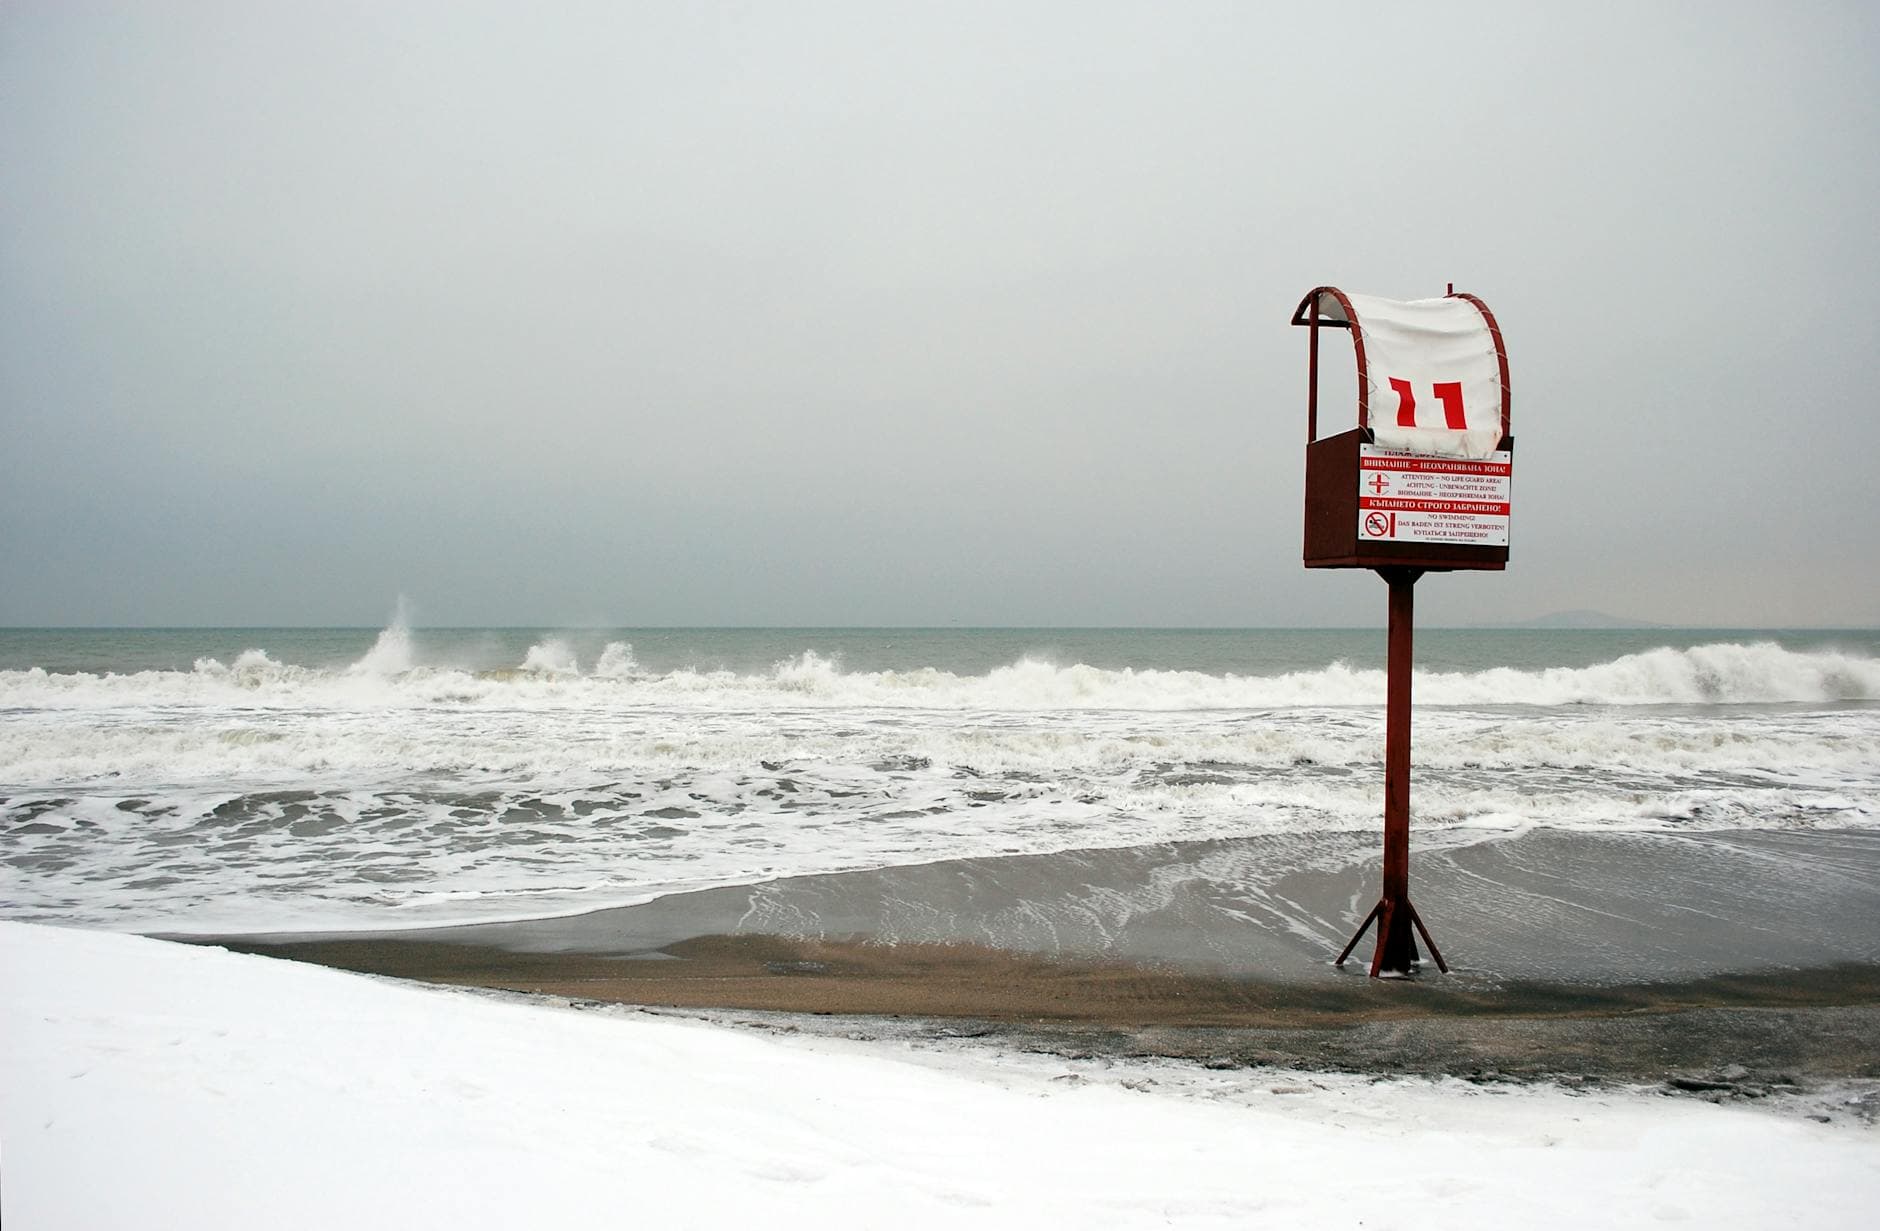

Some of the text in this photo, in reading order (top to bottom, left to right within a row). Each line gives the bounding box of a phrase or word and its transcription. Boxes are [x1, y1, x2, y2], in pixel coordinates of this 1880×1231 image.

[1388, 376, 1467, 430] 11
[1364, 459, 1411, 468] ВНИМАНИЕ
[1420, 461, 1482, 471] НЕОХРАНЯВАНА
[1484, 464, 1506, 473] ЗОНА!
[1369, 499, 1502, 512] КЪПАНЕТО СТРОГО ЗАБРАНЕНО!
[1471, 523, 1505, 531] VERBOTEN!
